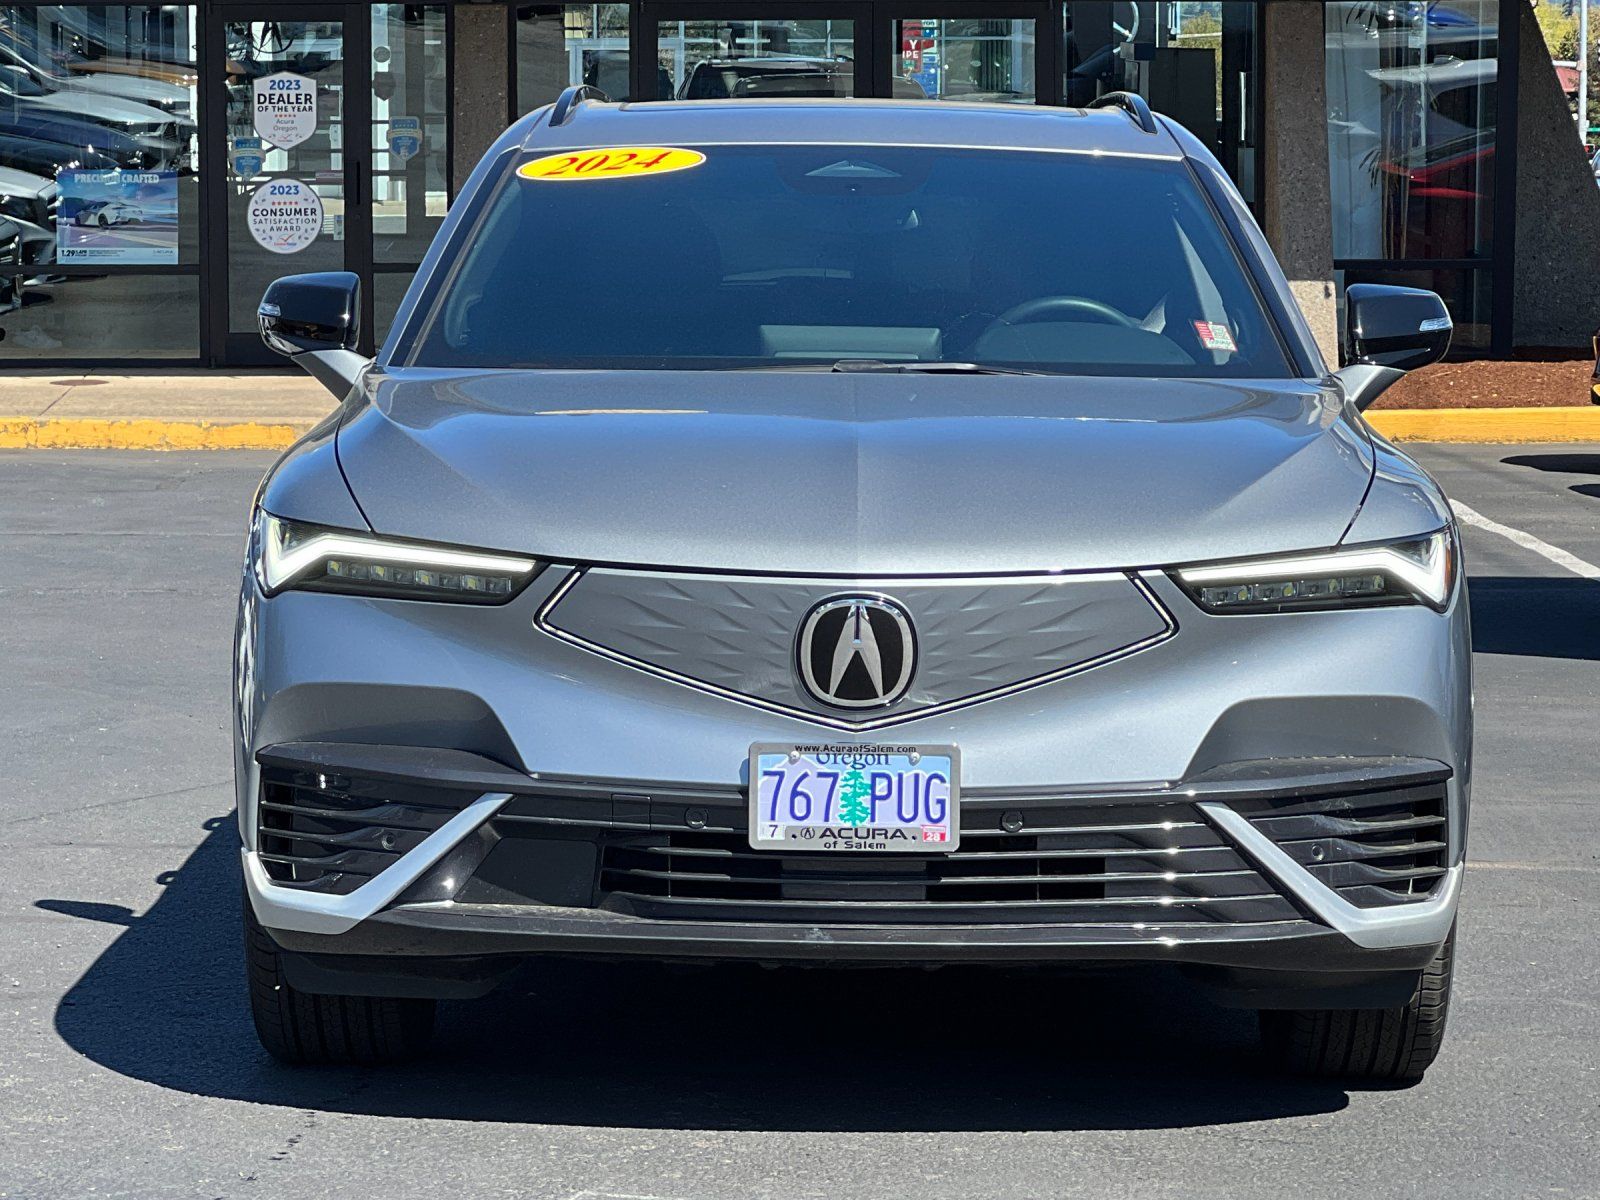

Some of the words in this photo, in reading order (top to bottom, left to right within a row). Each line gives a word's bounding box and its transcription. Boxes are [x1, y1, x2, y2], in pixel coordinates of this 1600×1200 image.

[269, 79, 301, 91] 2023
[257, 93, 313, 105] DEALER
[257, 105, 269, 113] OF
[272, 105, 289, 113] THE
[291, 105, 314, 113] YEAR
[273, 125, 298, 133] Oregon
[540, 151, 672, 177] 2024
[74, 173, 120, 184] PRECI
[122, 173, 160, 184] CRAFTED
[270, 185, 300, 195] 2023
[252, 207, 317, 217] CONSUMER
[253, 217, 317, 225] SATISFACTION
[794, 744, 917, 754] www.AcuraofSalem.com
[815, 752, 891, 770] Oregon
[763, 770, 840, 823] 767
[869, 771, 948, 824] PUG
[768, 825, 779, 838] 7
[819, 827, 908, 840] ACURA
[824, 840, 839, 849] of
[844, 840, 887, 850] Salem
